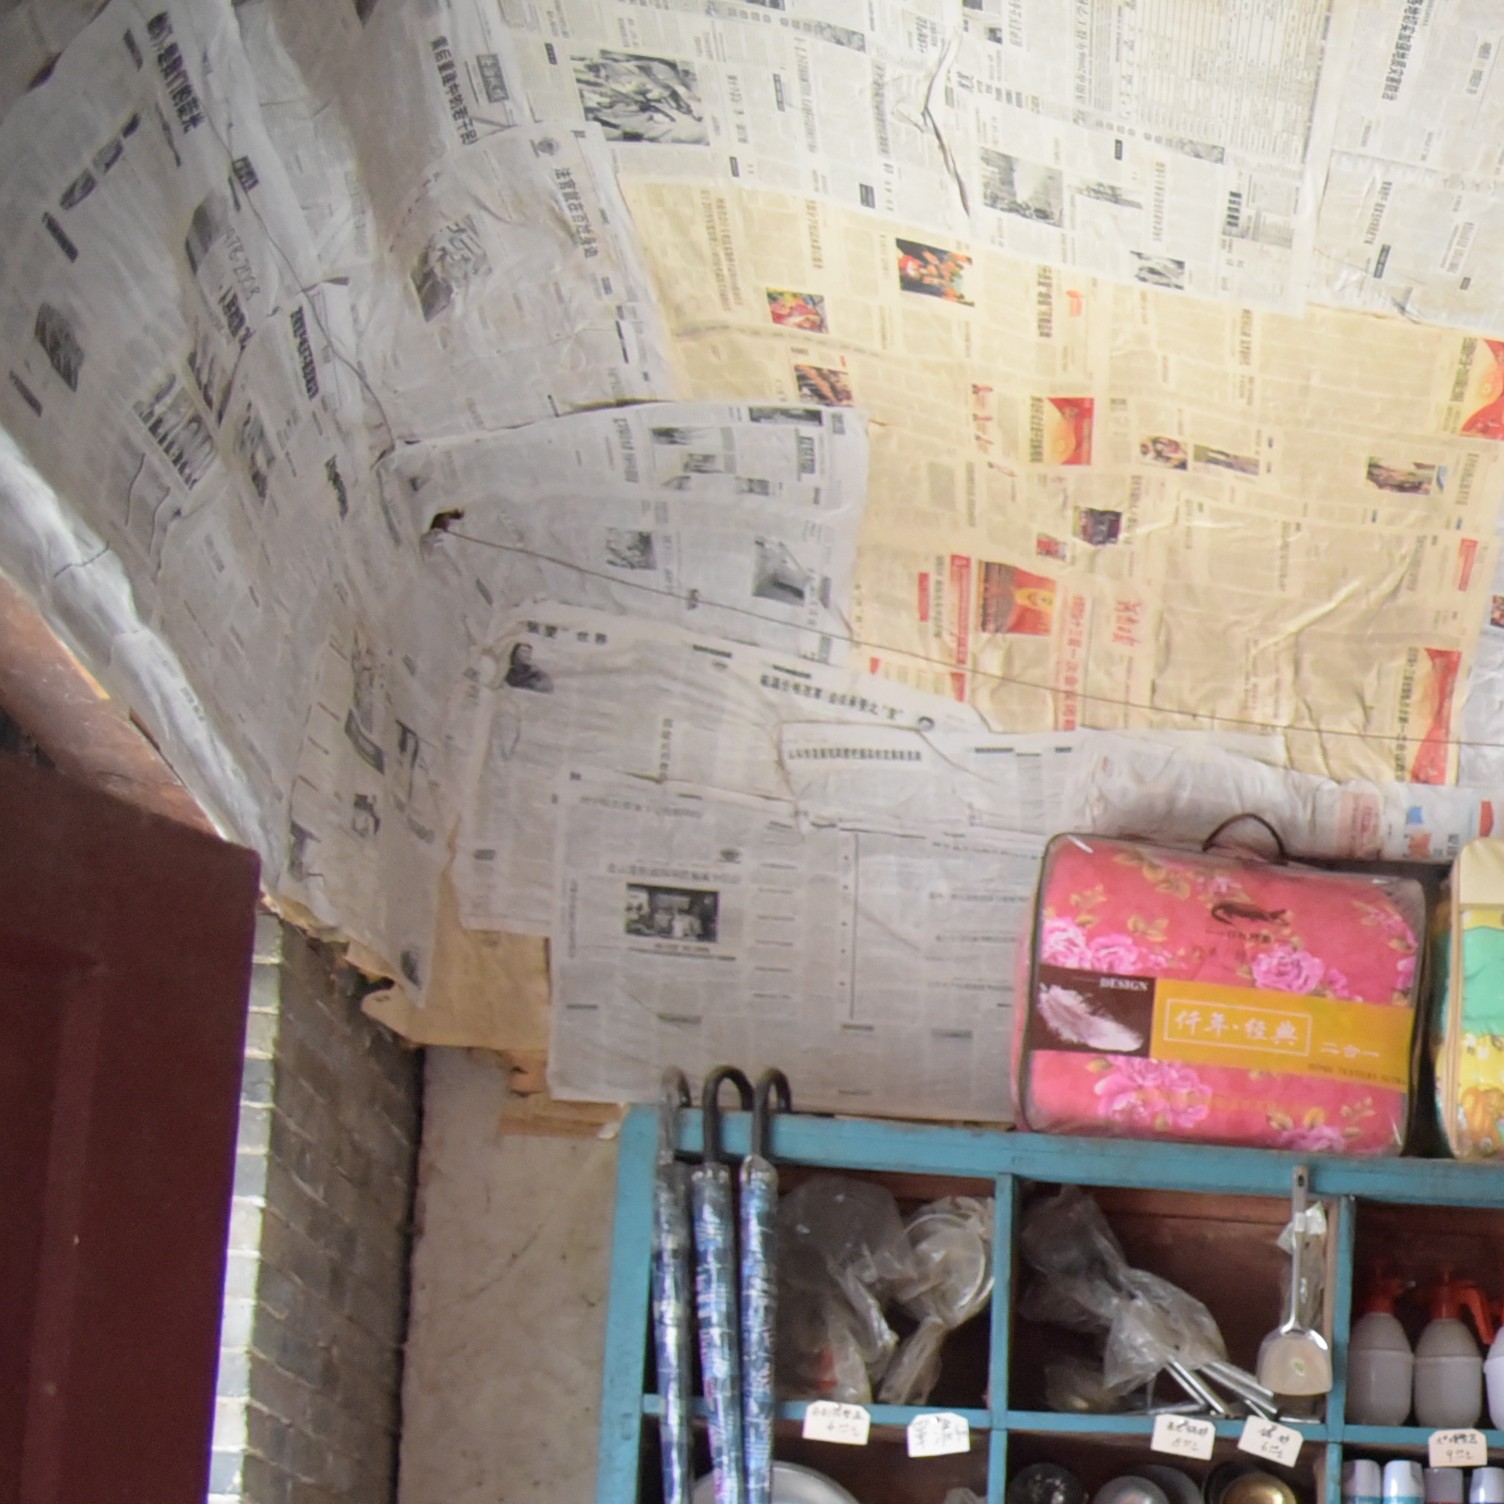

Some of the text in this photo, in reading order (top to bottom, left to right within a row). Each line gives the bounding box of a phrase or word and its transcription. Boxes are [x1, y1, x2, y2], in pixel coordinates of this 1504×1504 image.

[1098, 977, 1148, 991] DESIGN
[1319, 1042, 1382, 1059] 二合一
